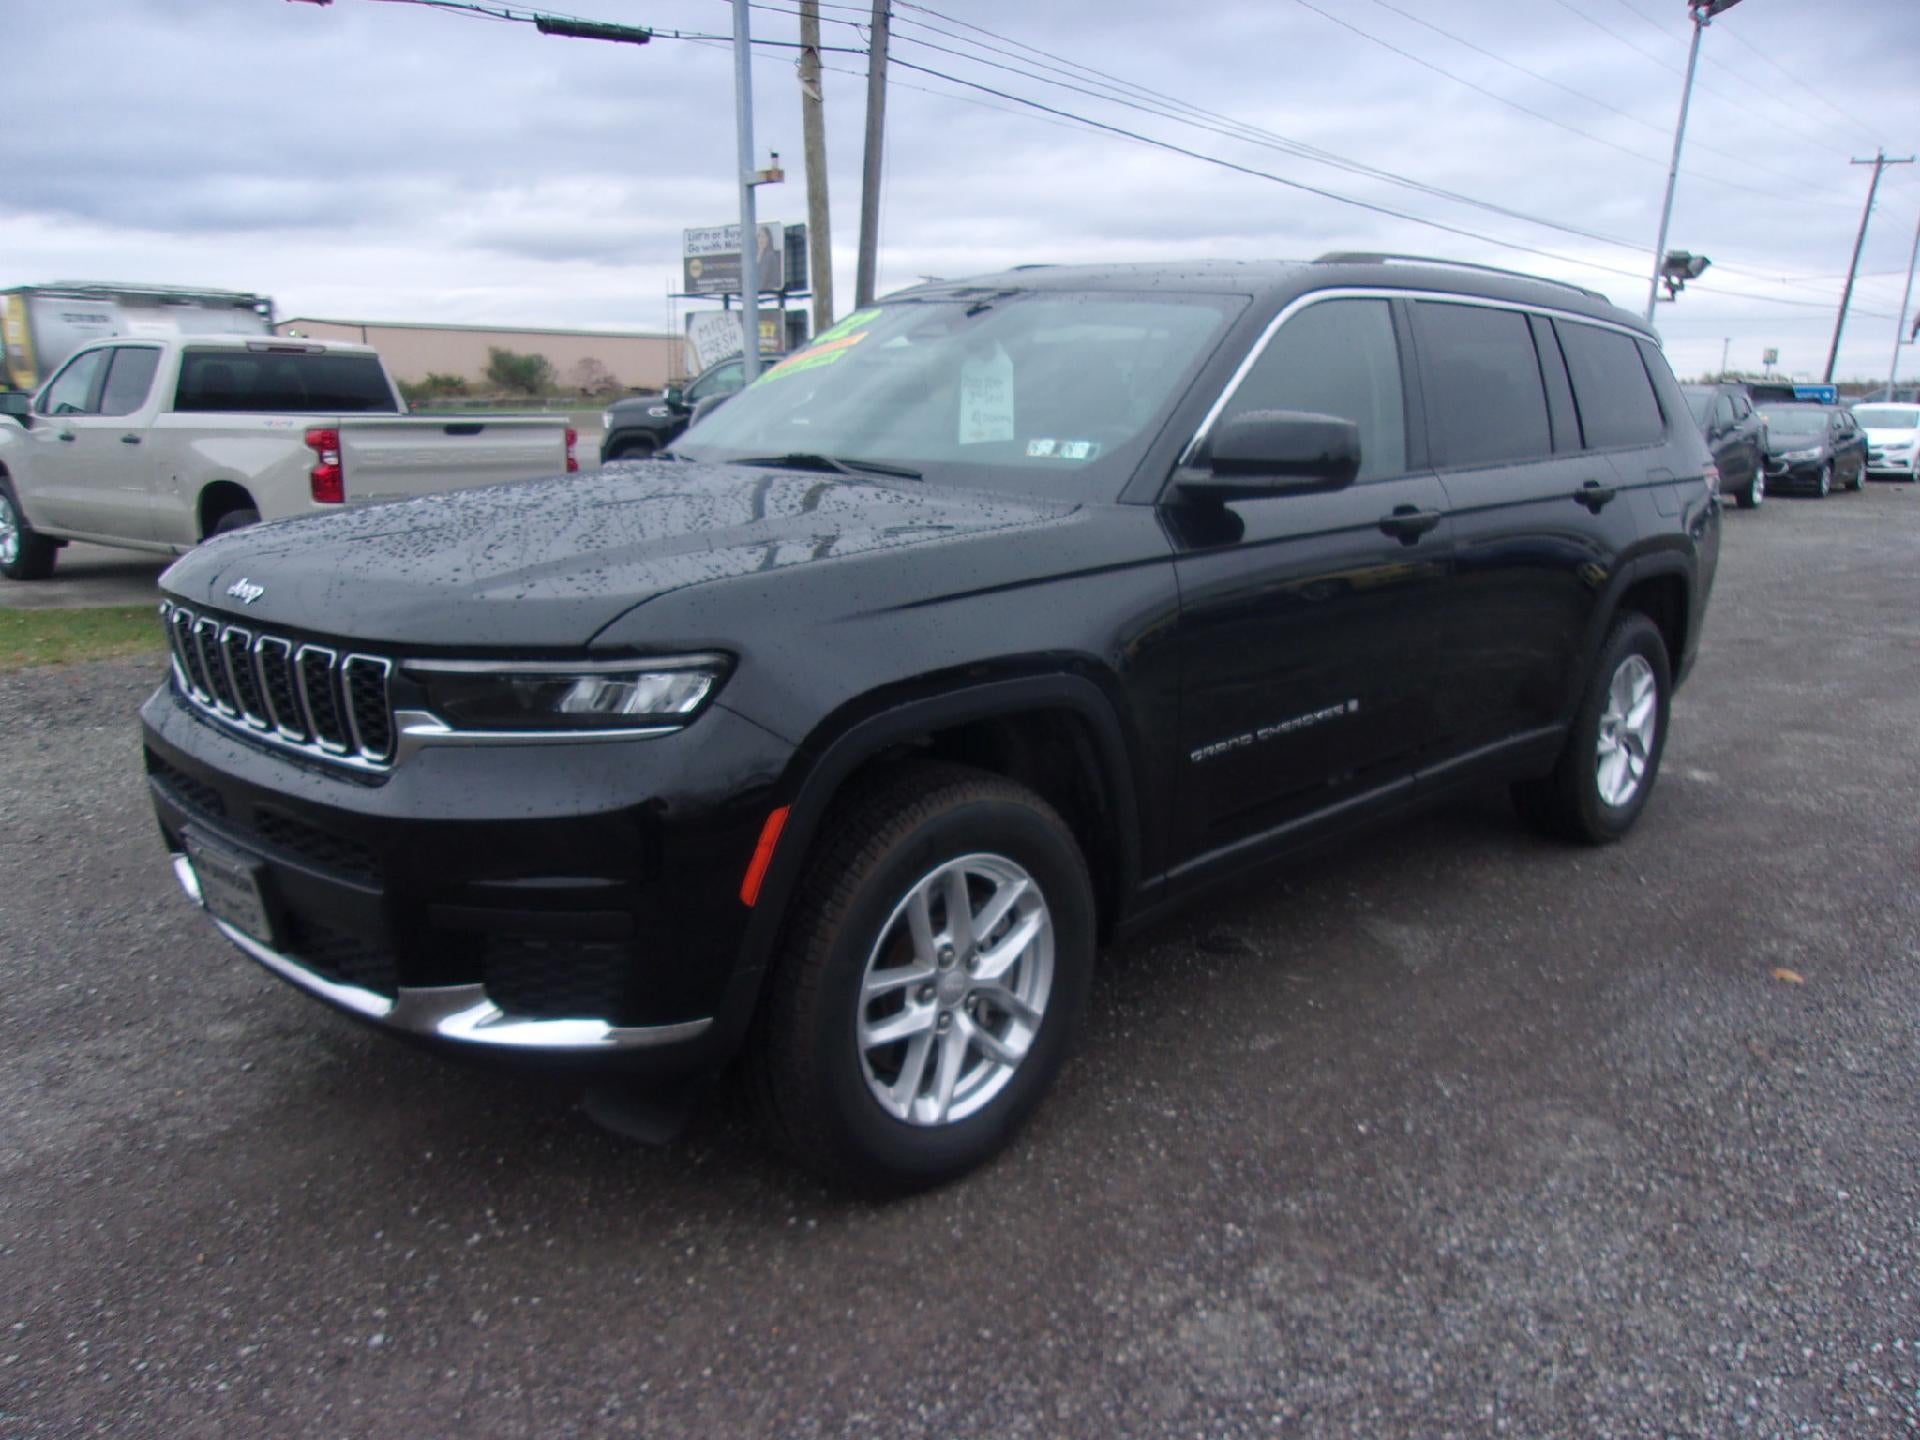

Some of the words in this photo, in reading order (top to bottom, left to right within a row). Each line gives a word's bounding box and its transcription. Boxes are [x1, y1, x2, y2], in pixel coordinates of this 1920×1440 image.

[712, 231, 721, 240] or
[687, 243, 700, 253] Go
[701, 240, 722, 251] with
[226, 577, 264, 605] Jeep
[1190, 733, 1253, 762] GRAND
[1257, 703, 1345, 740] CHEROKEE
